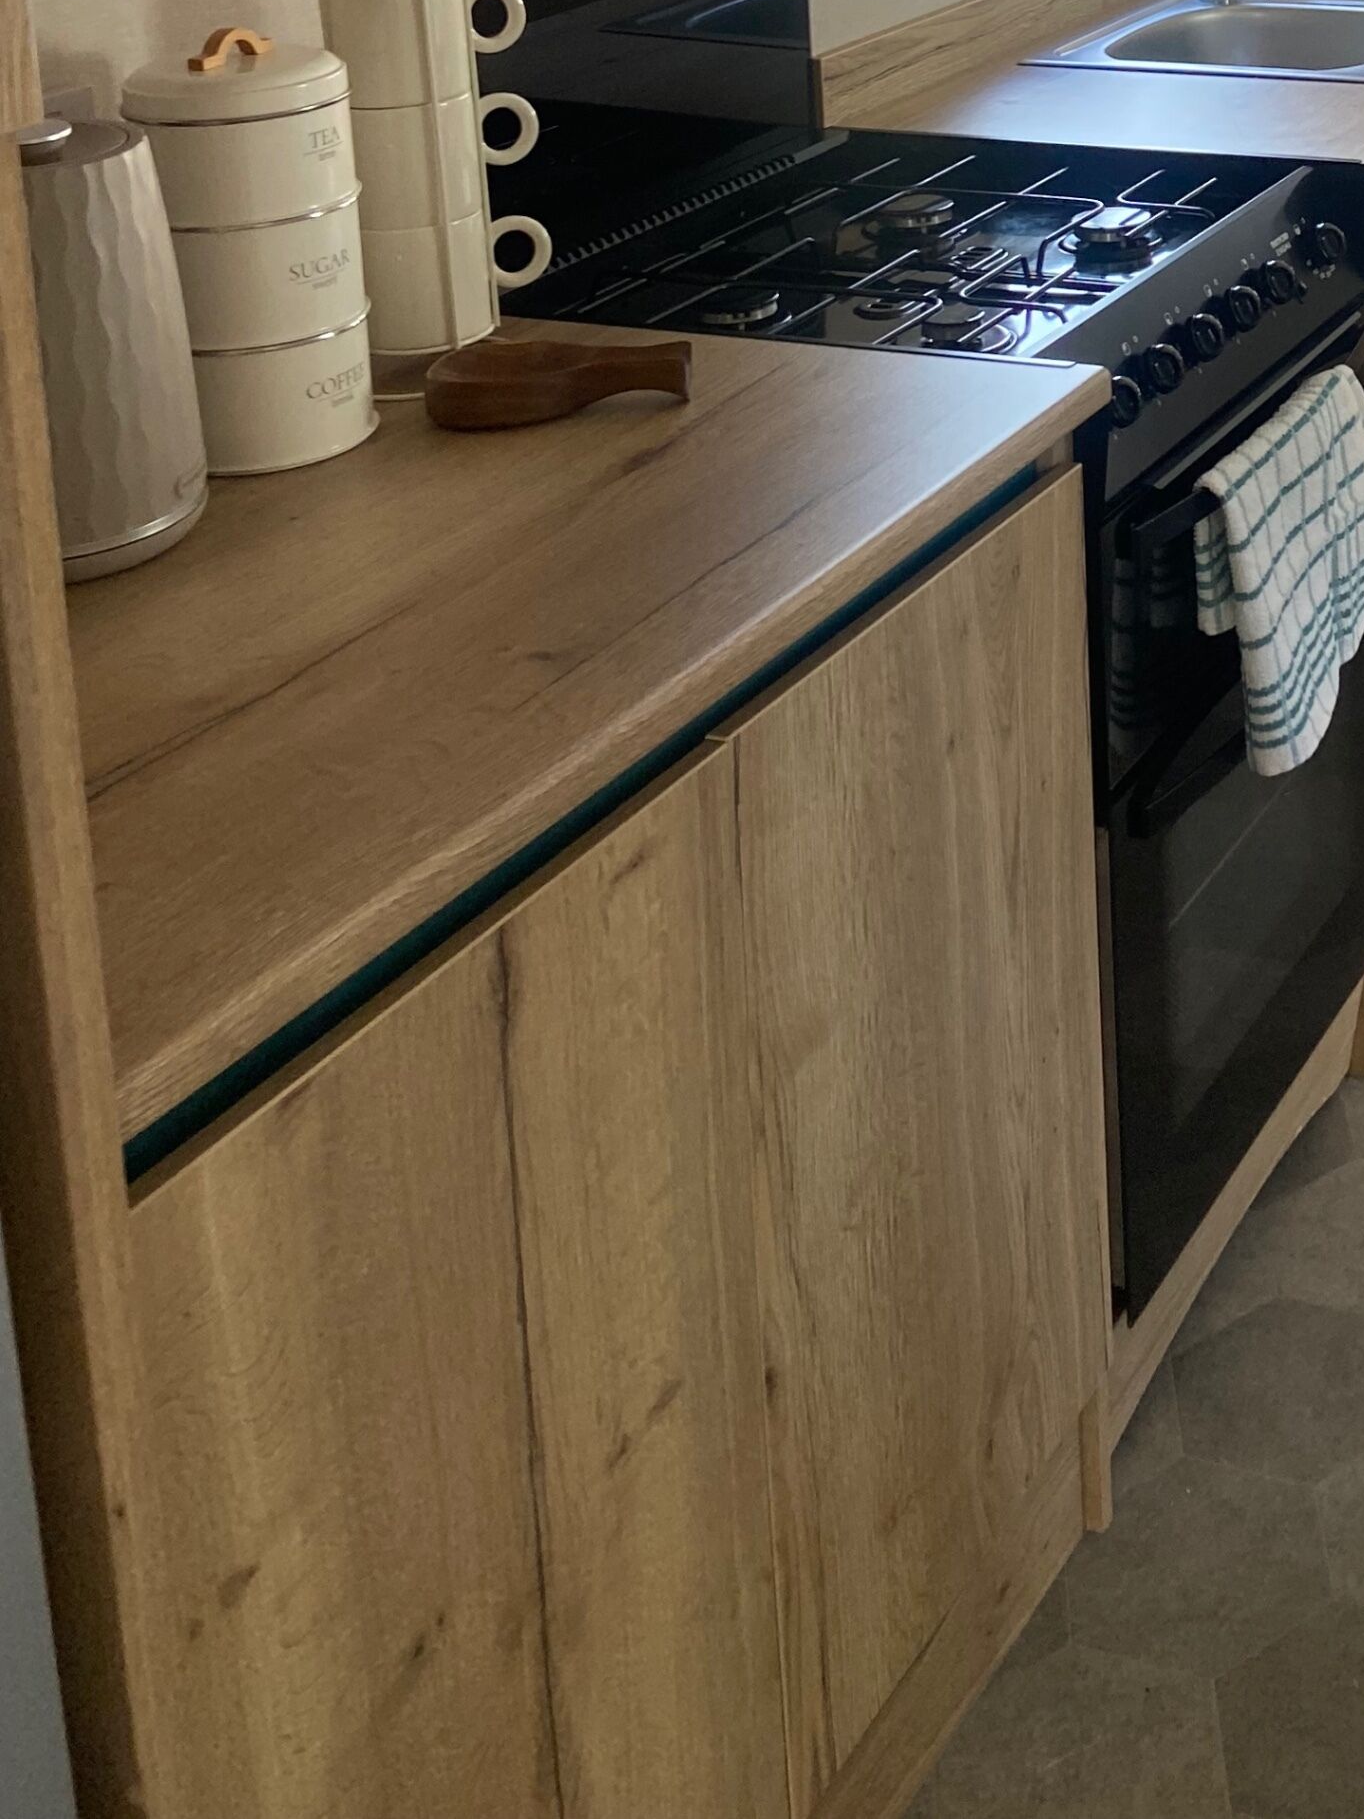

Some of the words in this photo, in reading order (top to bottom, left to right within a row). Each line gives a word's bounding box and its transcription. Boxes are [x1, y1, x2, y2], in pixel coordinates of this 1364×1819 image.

[308, 125, 341, 149] TEA
[288, 248, 350, 282] SUGAR
[306, 361, 365, 399] COFFEE
